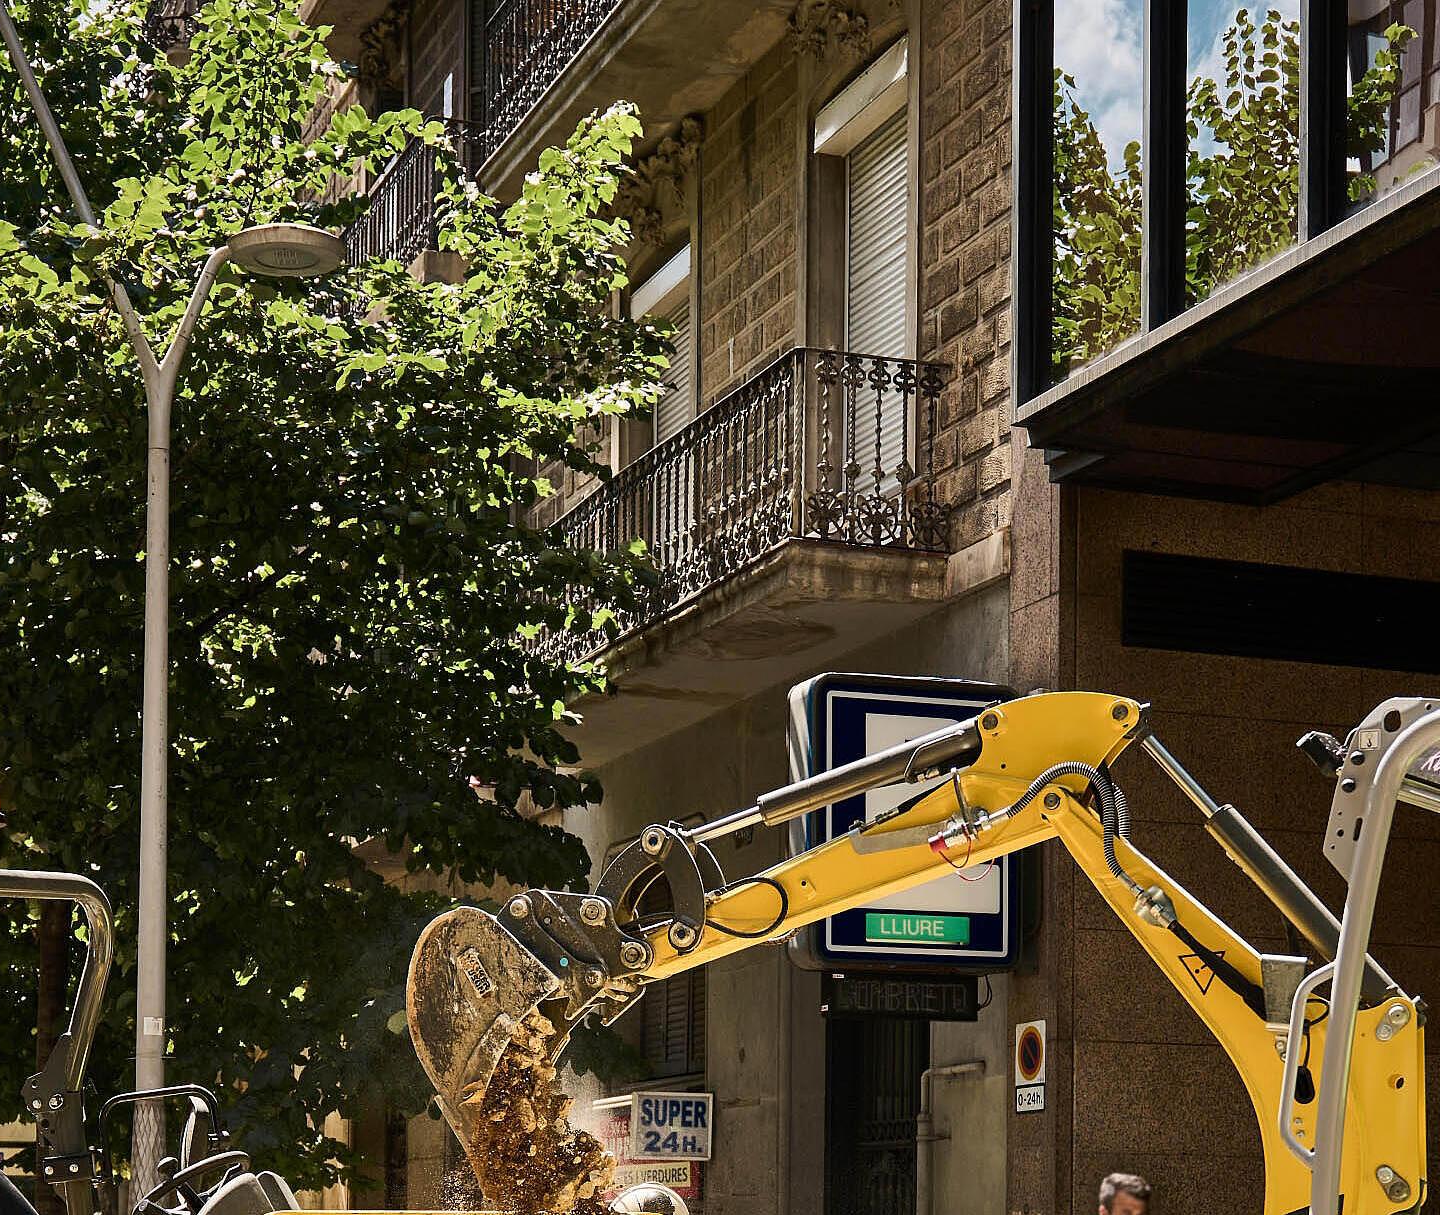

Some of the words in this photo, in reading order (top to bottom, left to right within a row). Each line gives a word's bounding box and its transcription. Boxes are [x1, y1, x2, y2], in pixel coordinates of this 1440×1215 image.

[880, 917, 945, 938] LLIURE
[1017, 1093, 1043, 1107] 0-24h.
[640, 1098, 707, 1128] SUPER
[640, 1166, 689, 1185] VERDURES
